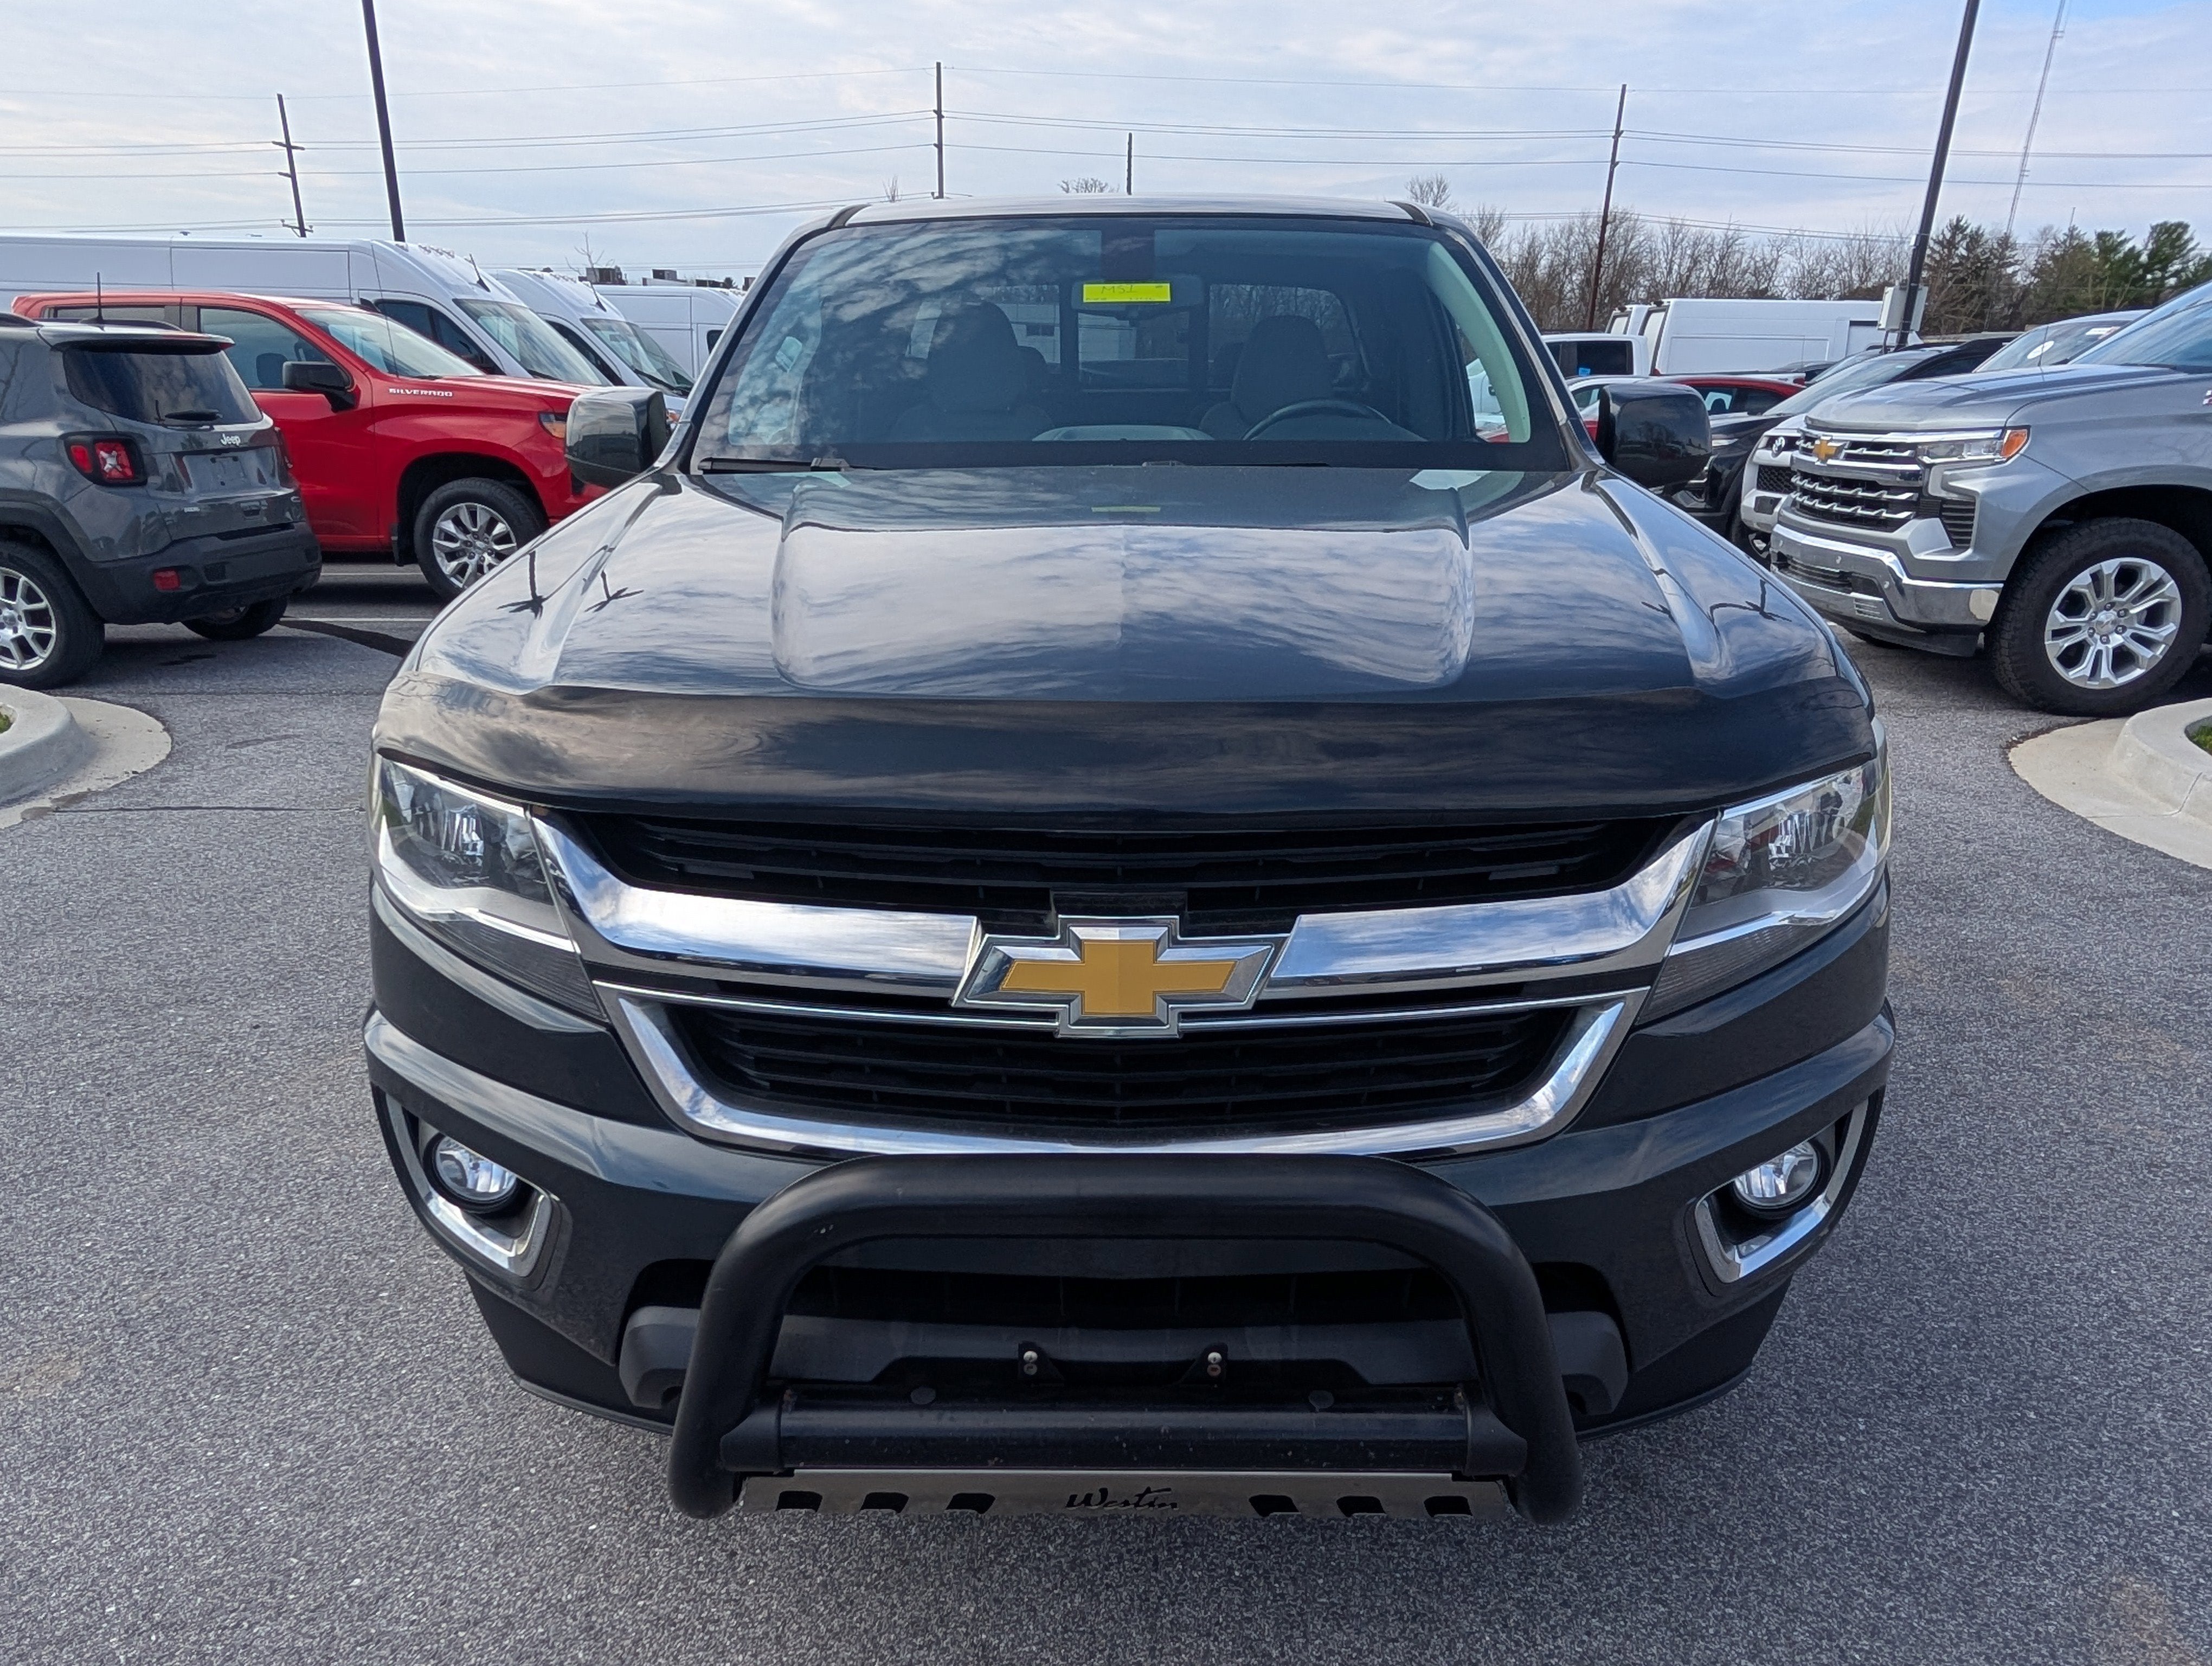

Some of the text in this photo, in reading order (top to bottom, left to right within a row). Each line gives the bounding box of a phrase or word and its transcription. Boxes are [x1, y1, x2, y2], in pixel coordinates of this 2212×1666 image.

[389, 388, 453, 397] SILVERADO
[221, 434, 241, 446] Jeep
[1065, 1486, 1179, 1510] Westin
